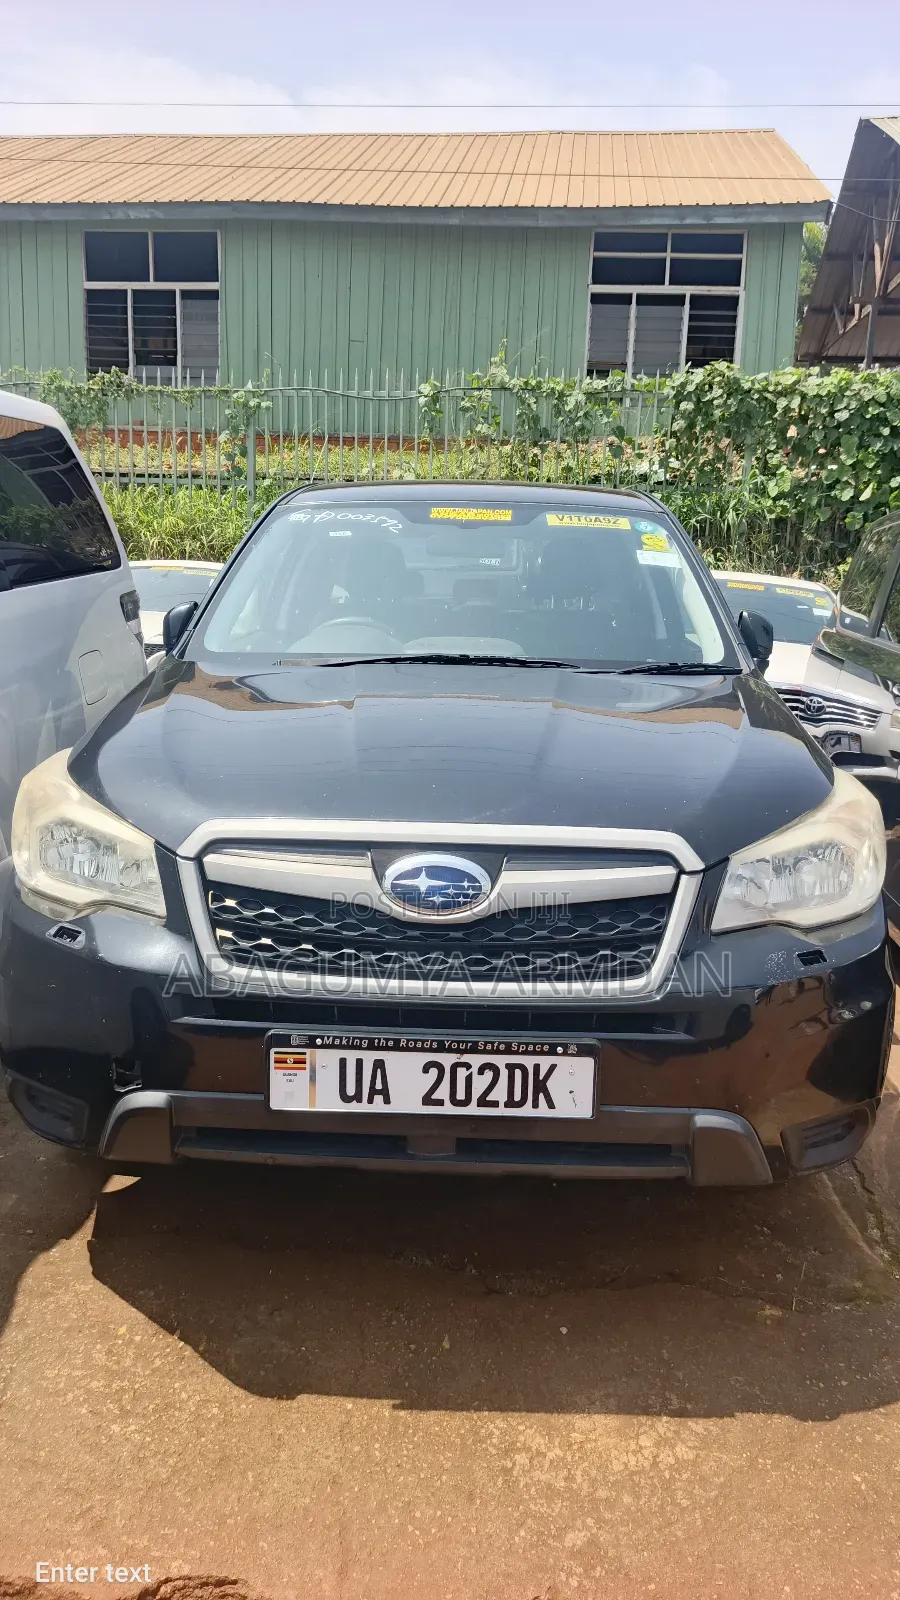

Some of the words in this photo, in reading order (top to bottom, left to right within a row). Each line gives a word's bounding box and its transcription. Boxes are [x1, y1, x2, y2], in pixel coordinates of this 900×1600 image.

[323, 1036, 369, 1048] Making
[374, 1038, 394, 1047] the
[400, 1039, 438, 1049] Roads
[444, 1040, 473, 1050] Your
[478, 1041, 506, 1051] Safe
[511, 1042, 550, 1053] Space
[338, 1057, 392, 1105] UA
[421, 1060, 558, 1110] 202DK
